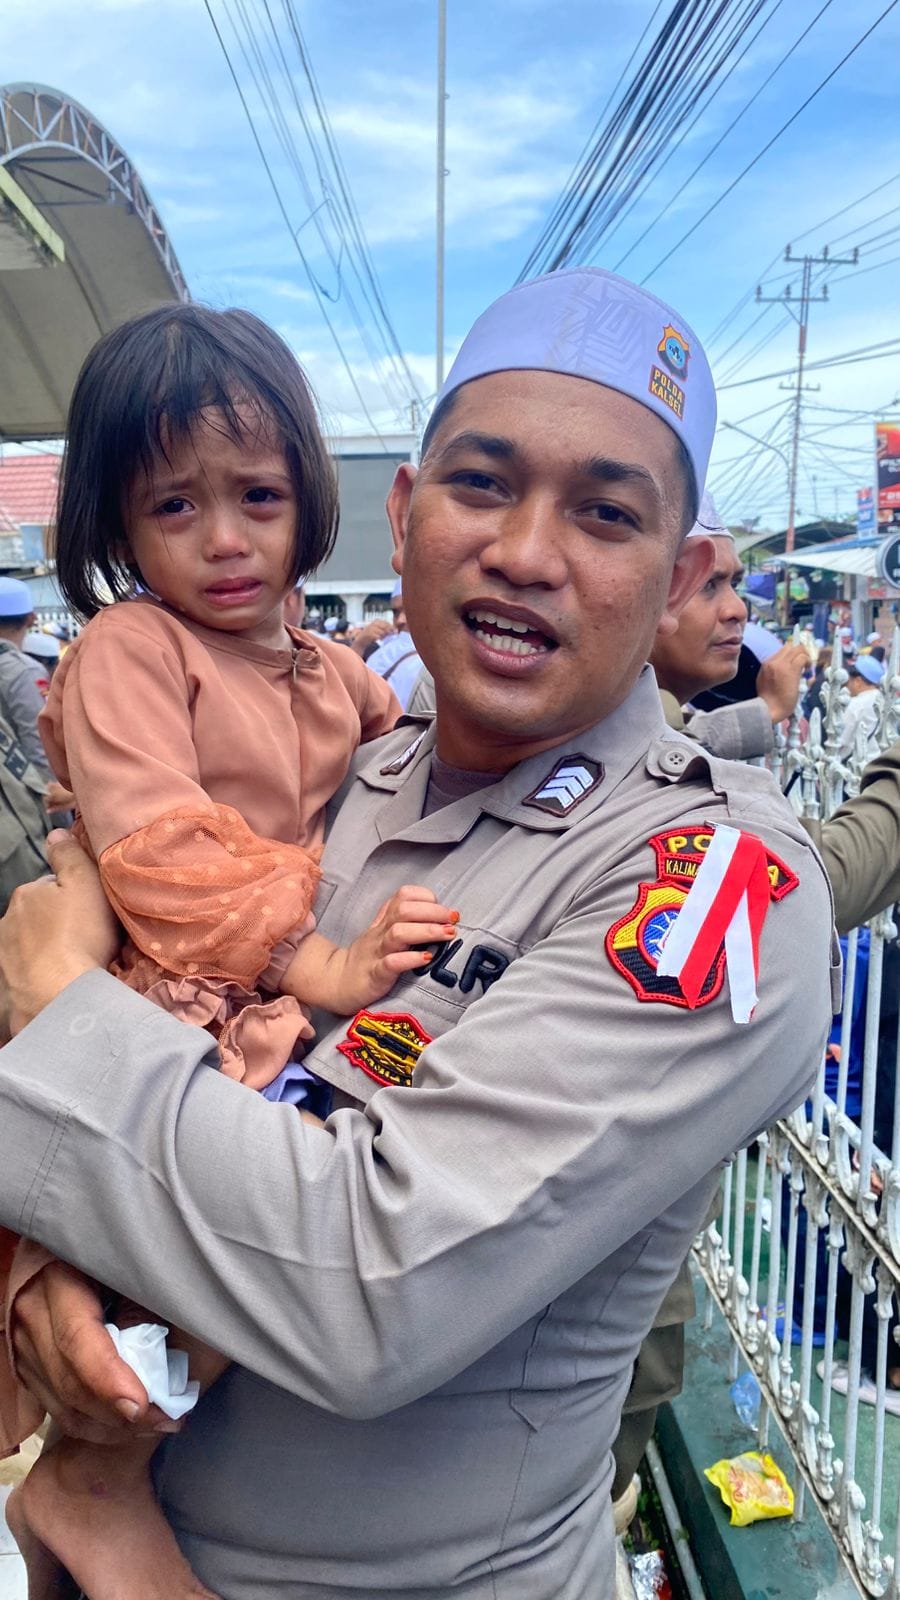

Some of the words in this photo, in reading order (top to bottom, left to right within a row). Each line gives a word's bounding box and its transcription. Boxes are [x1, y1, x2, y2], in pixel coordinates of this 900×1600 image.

[651, 380, 682, 418] KALSEL
[654, 369, 684, 403] POLDA
[666, 859, 698, 878] KALIM
